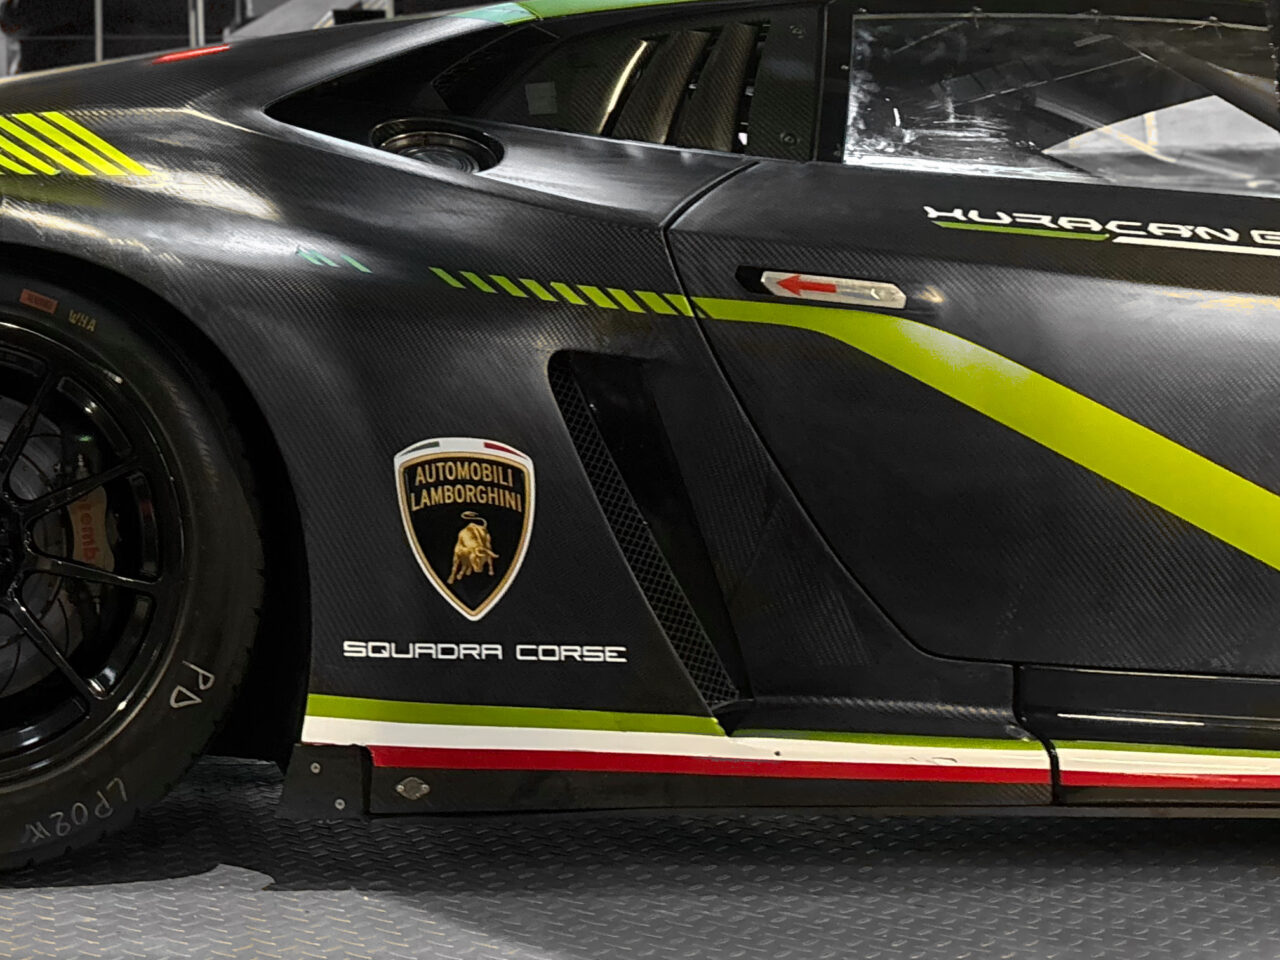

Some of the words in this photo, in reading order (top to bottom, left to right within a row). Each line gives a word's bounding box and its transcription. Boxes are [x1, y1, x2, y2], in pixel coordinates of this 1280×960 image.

[414, 461, 513, 487] AUTOMOBILI
[410, 484, 522, 513] LAMBORGHINI
[343, 641, 503, 659] SQUADRA
[516, 644, 628, 663] CORSE
